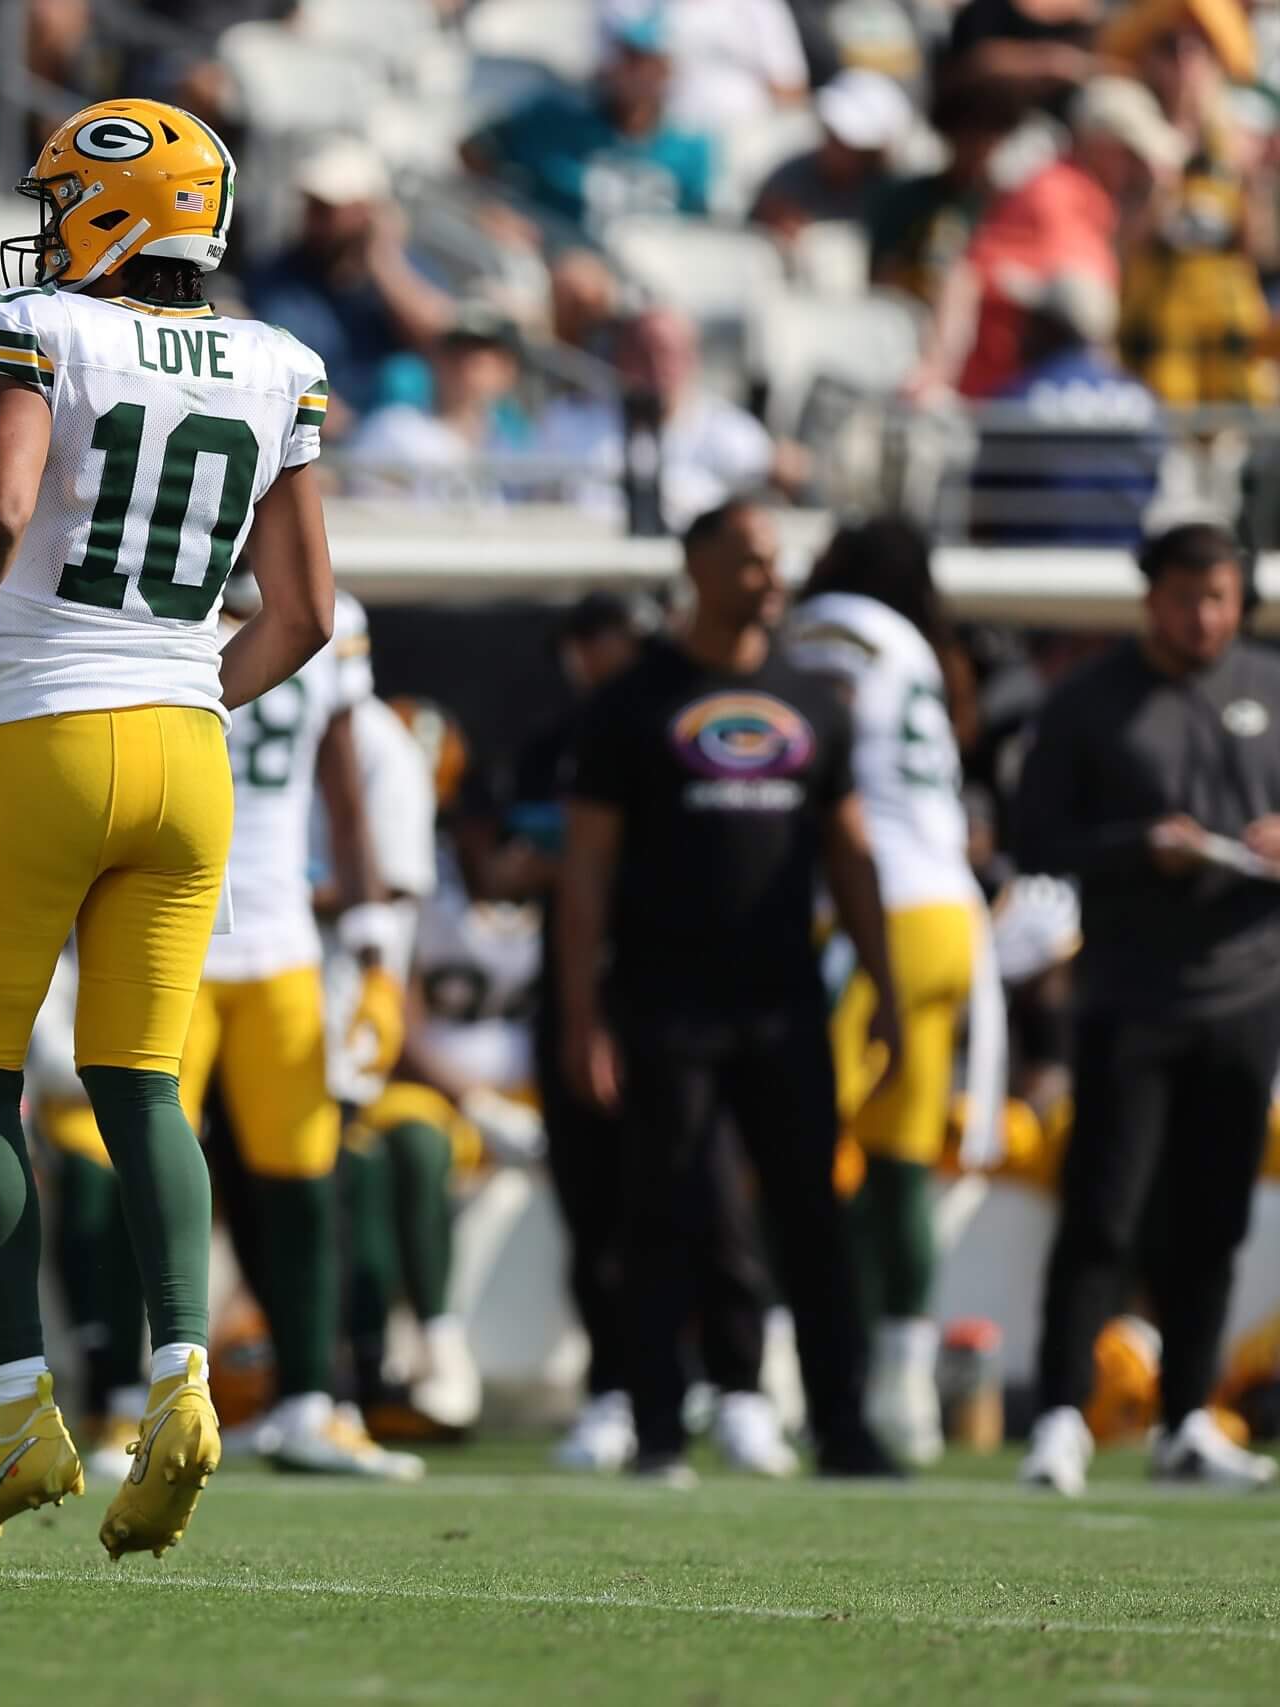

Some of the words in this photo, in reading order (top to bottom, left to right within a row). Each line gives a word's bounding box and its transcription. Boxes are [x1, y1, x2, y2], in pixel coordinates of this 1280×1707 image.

[73, 116, 154, 162] G
[134, 320, 233, 379] LOVE
[56, 402, 259, 621] 10
